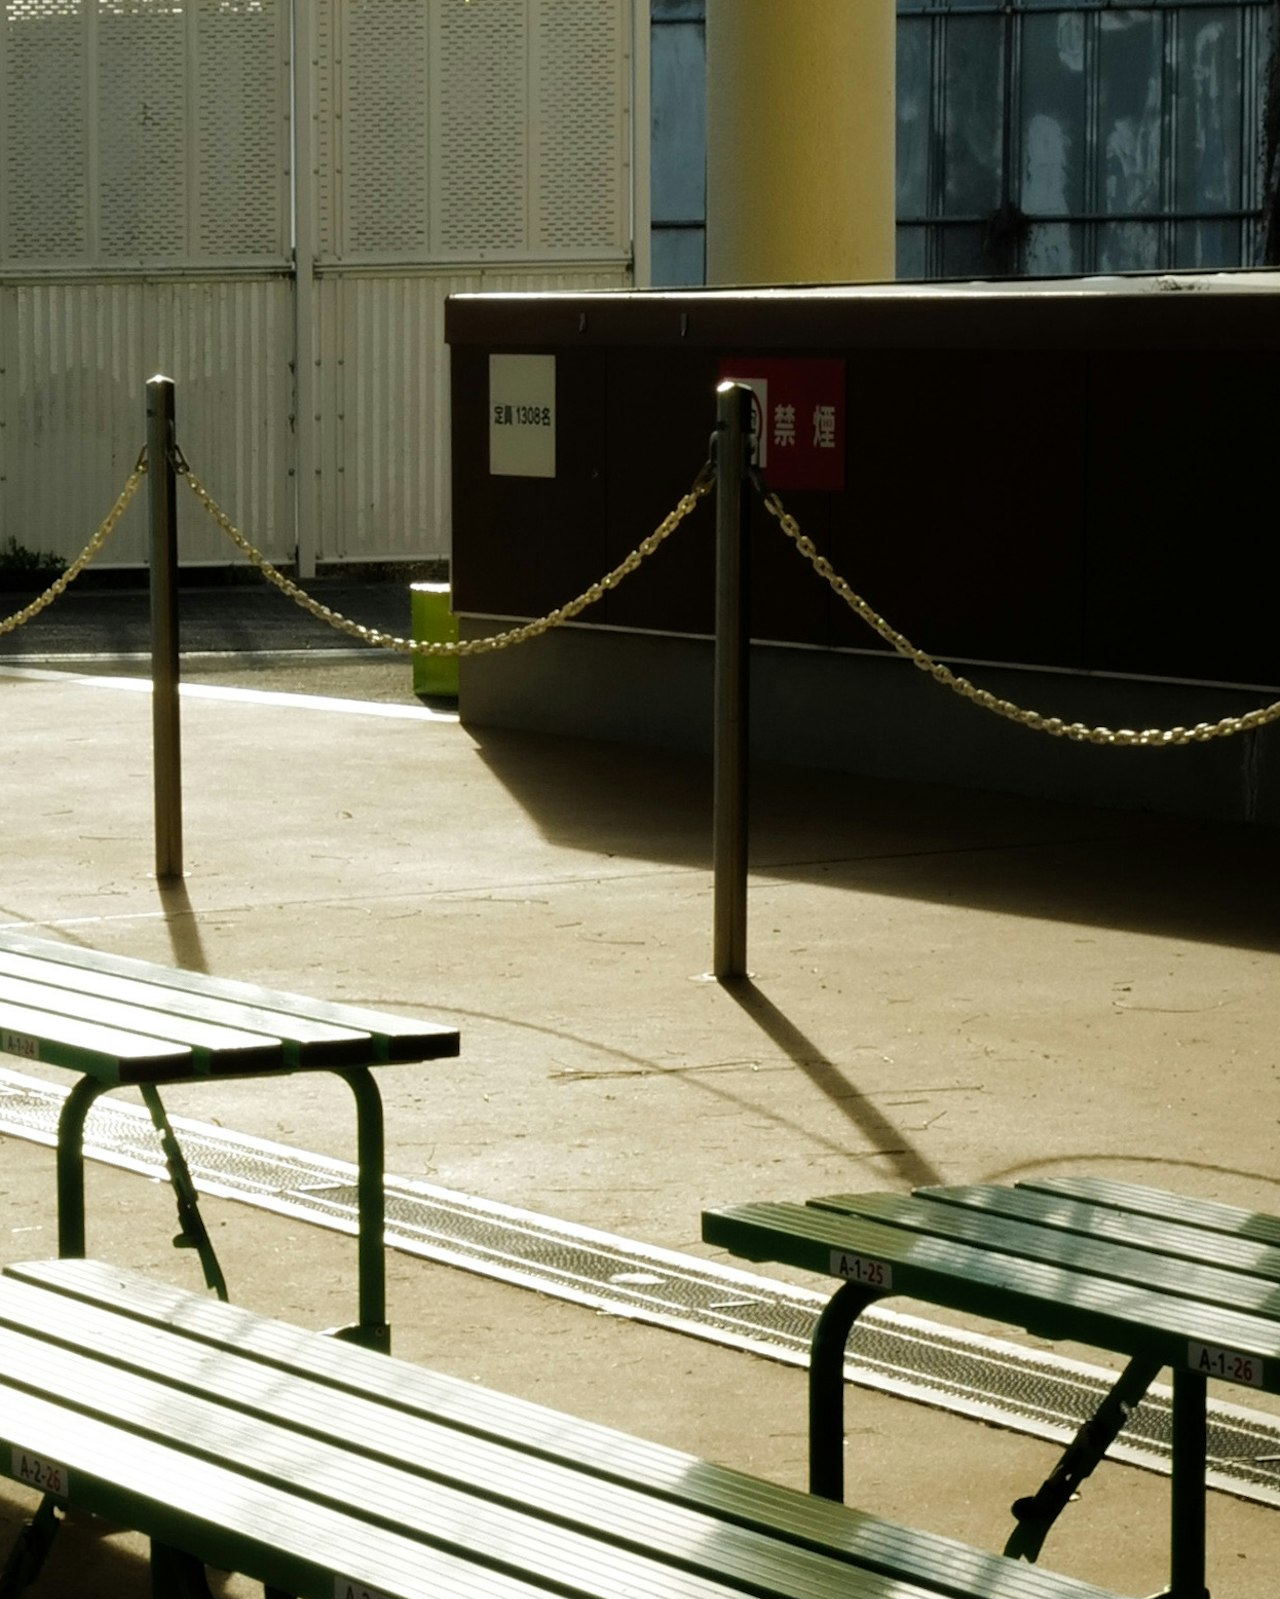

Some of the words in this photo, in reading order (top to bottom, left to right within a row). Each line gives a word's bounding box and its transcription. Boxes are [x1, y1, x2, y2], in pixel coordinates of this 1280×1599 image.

[773, 403, 836, 448] 禁煙
[839, 1256, 883, 1284] A-1-25
[1199, 1348, 1252, 1381] A-1-26
[20, 1454, 61, 1492] A-2-26
